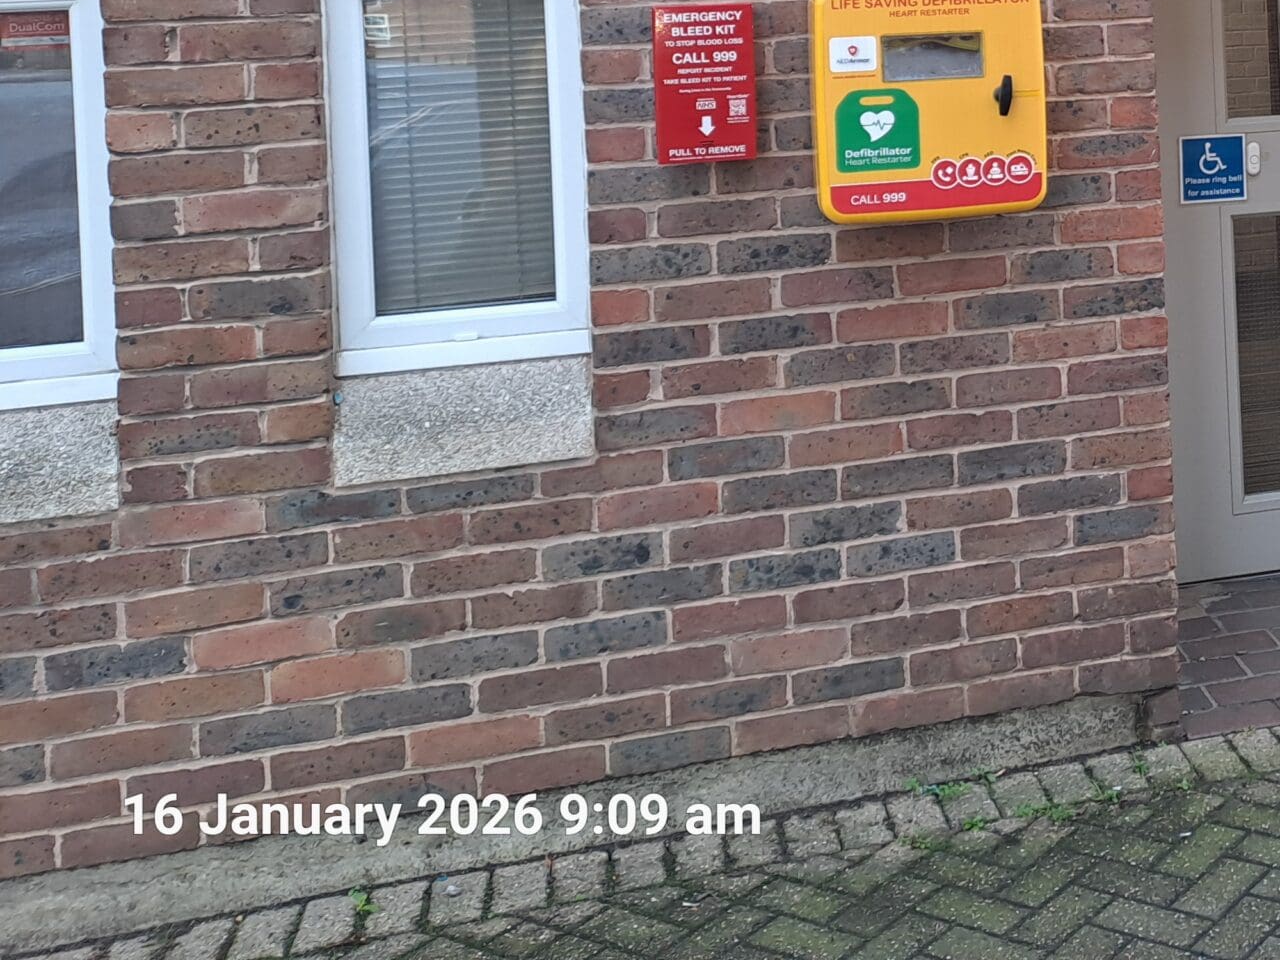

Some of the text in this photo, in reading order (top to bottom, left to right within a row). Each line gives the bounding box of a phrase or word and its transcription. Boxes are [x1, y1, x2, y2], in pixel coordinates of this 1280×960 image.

[663, 11, 742, 23] EMERGENCY
[889, 7, 970, 18] HEART RESTARTER
[9, 22, 65, 32] DualCom
[671, 24, 736, 37] BLEED KIT
[672, 50, 738, 65] CALL 999
[677, 67, 703, 75] REPORT
[697, 101, 715, 109] NHS
[668, 144, 746, 157] PULL TO REMOVE
[845, 147, 912, 159] Defibrillator
[845, 156, 912, 166] Heart Restarter
[1185, 174, 1243, 185] Please ring bell
[1188, 187, 1241, 197] for assistance
[850, 191, 906, 205] CALL 999
